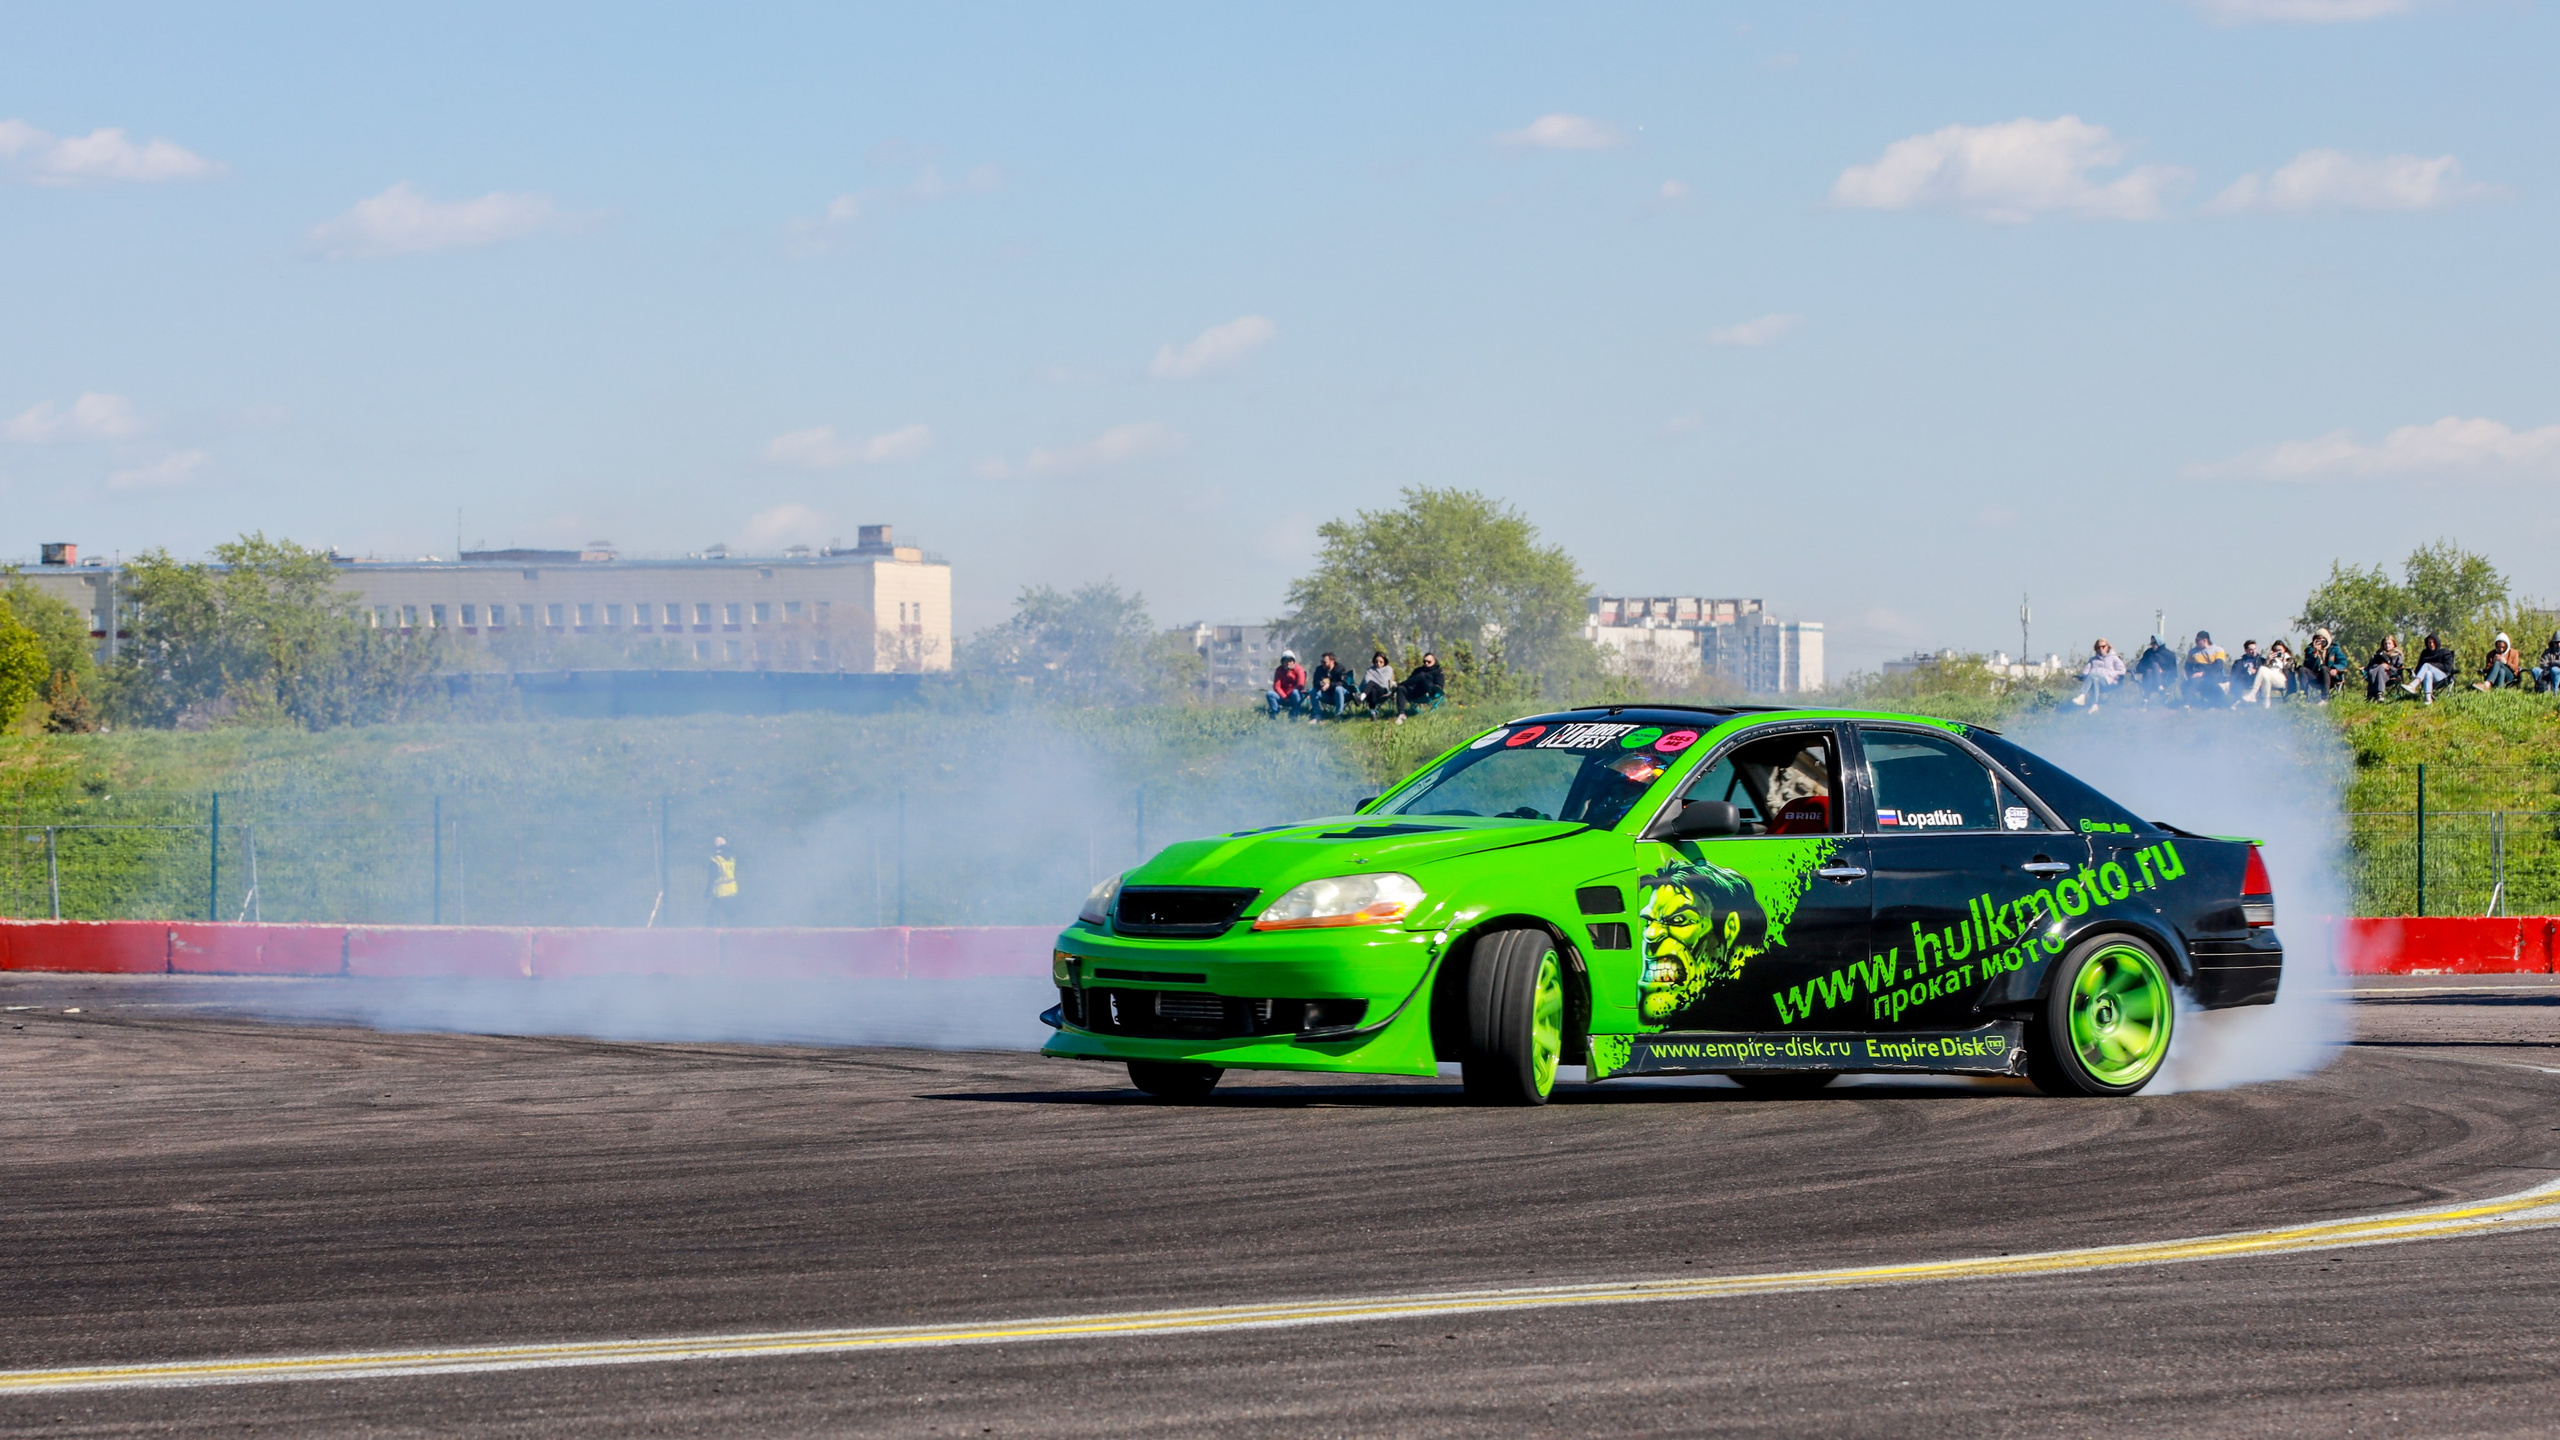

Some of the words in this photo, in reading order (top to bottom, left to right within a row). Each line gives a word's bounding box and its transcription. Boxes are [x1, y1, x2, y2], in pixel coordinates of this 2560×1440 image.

[1586, 724, 1640, 737] DRIFT
[1574, 736, 1617, 749] FEST
[1785, 812, 1823, 820] BRIDE
[1896, 809, 1963, 830] Lopatkin
[1773, 840, 2186, 1026] www.hulkmoto.ru
[1873, 964, 1974, 1023] прокат
[1650, 1037, 1851, 1062] www.empire-disk.ru
[1865, 1037, 1940, 1062] Empire
[1940, 1036, 1988, 1057] Disk
